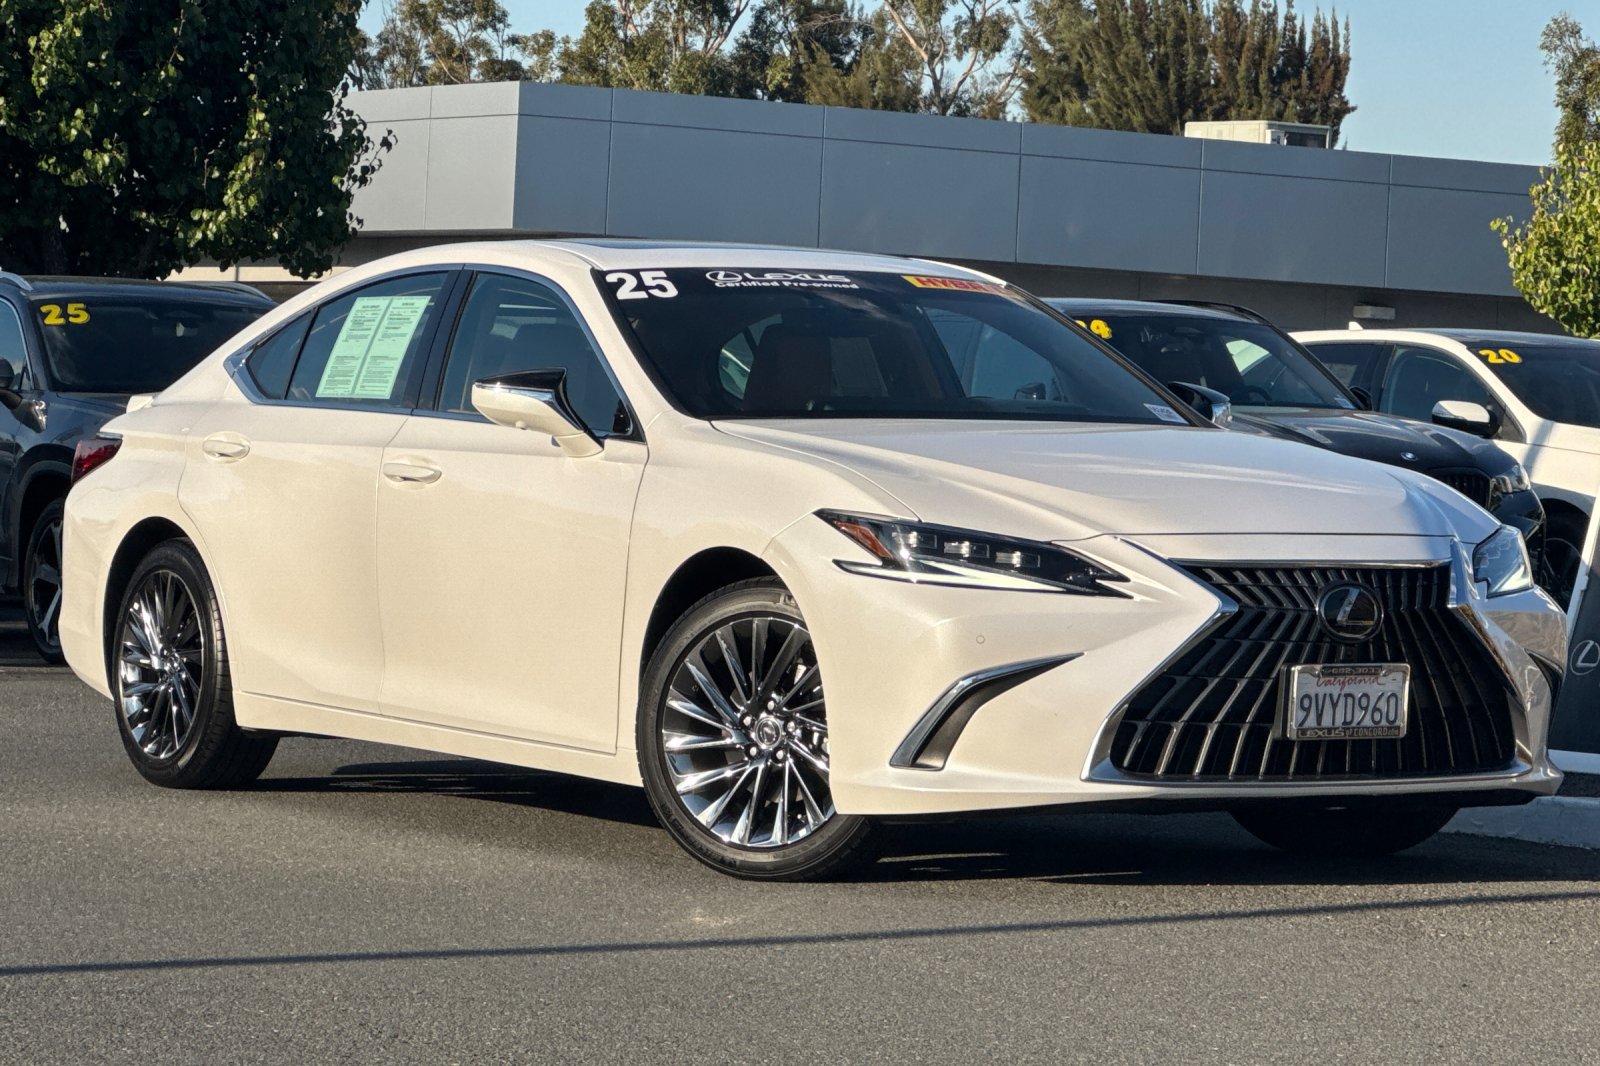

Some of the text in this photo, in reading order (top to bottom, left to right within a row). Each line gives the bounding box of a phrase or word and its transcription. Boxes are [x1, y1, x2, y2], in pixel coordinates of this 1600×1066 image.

[605, 270, 678, 300] 25
[715, 280, 860, 290] Certified Pre-owned
[743, 272, 851, 283] LEXUS
[914, 277, 1004, 293] HYBR
[40, 303, 90, 325] 25
[1075, 319, 1113, 340] 4
[1478, 348, 1522, 363] 20
[1315, 676, 1387, 692] California
[1298, 692, 1399, 727] 9VYD960
[1298, 728, 1345, 738] LEXUS
